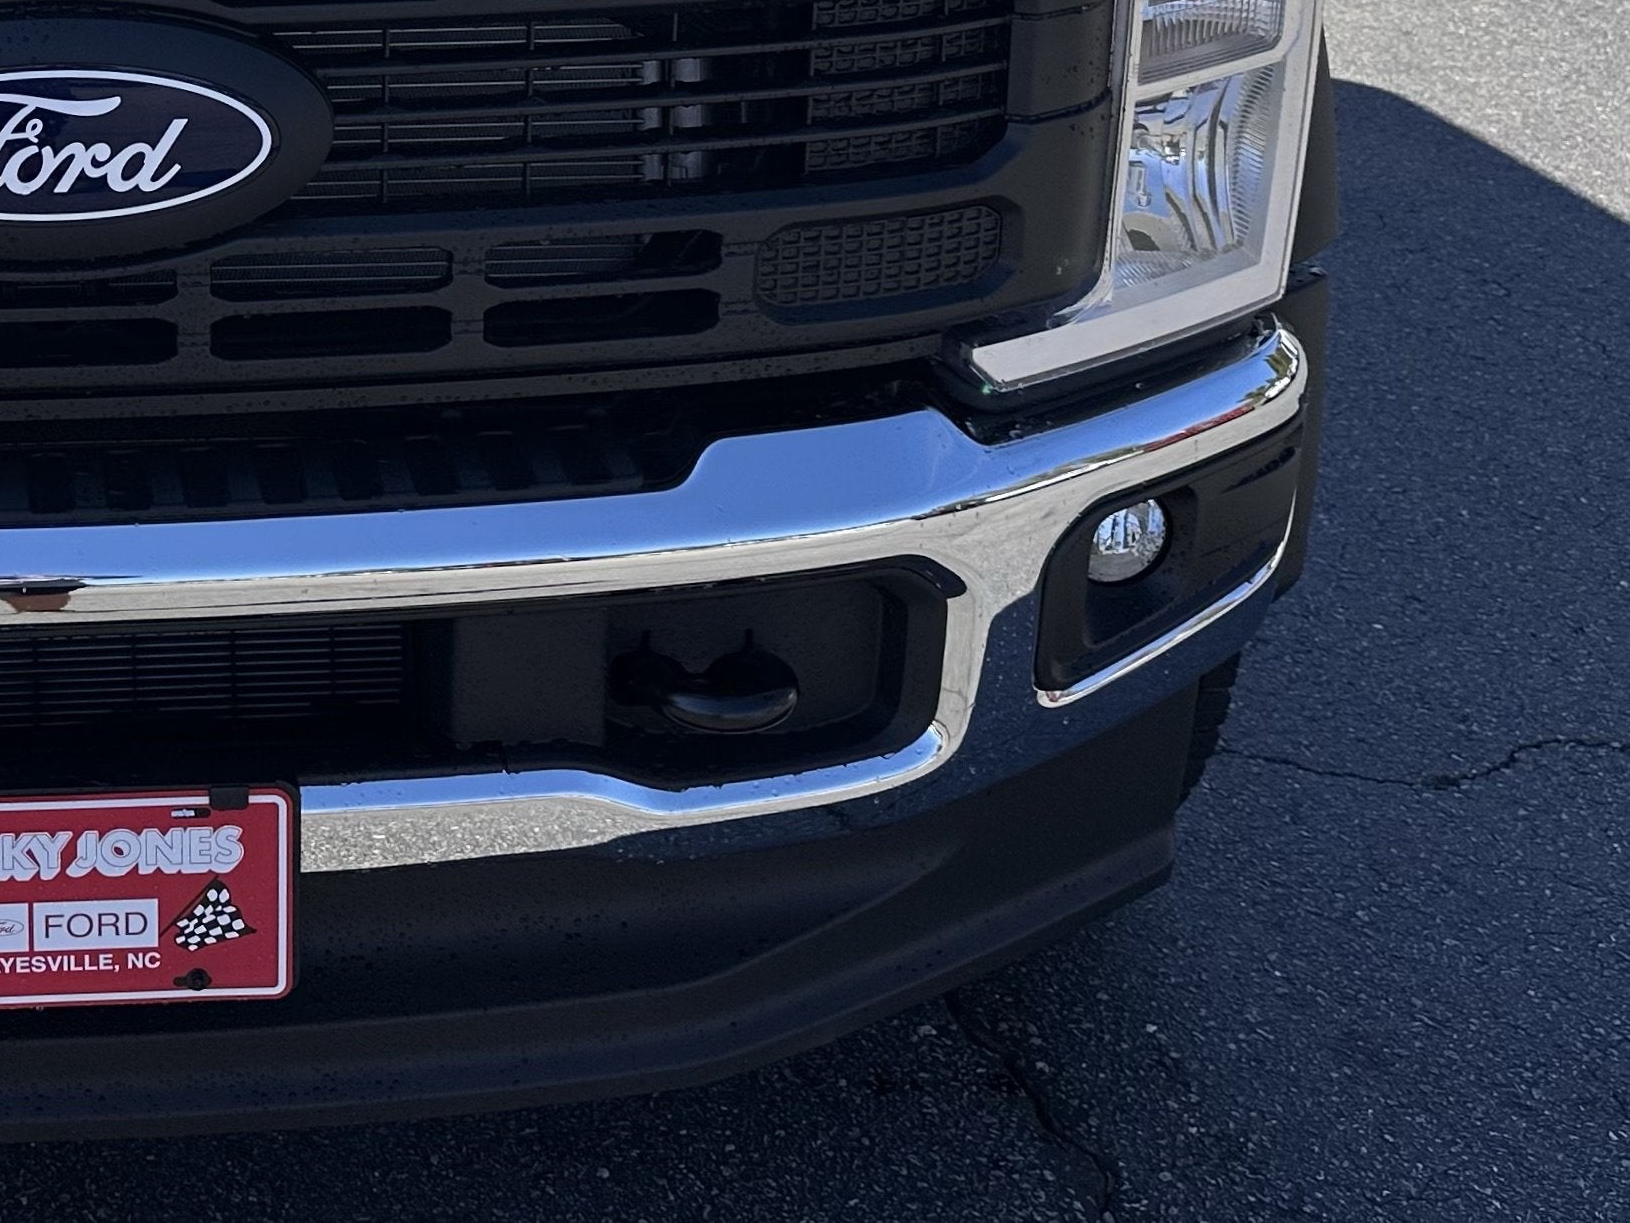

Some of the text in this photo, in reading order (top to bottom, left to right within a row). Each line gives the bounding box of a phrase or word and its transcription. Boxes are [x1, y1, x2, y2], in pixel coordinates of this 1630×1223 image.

[67, 825, 244, 878] JONES
[44, 911, 148, 939] FORD
[127, 951, 161, 971] NC
